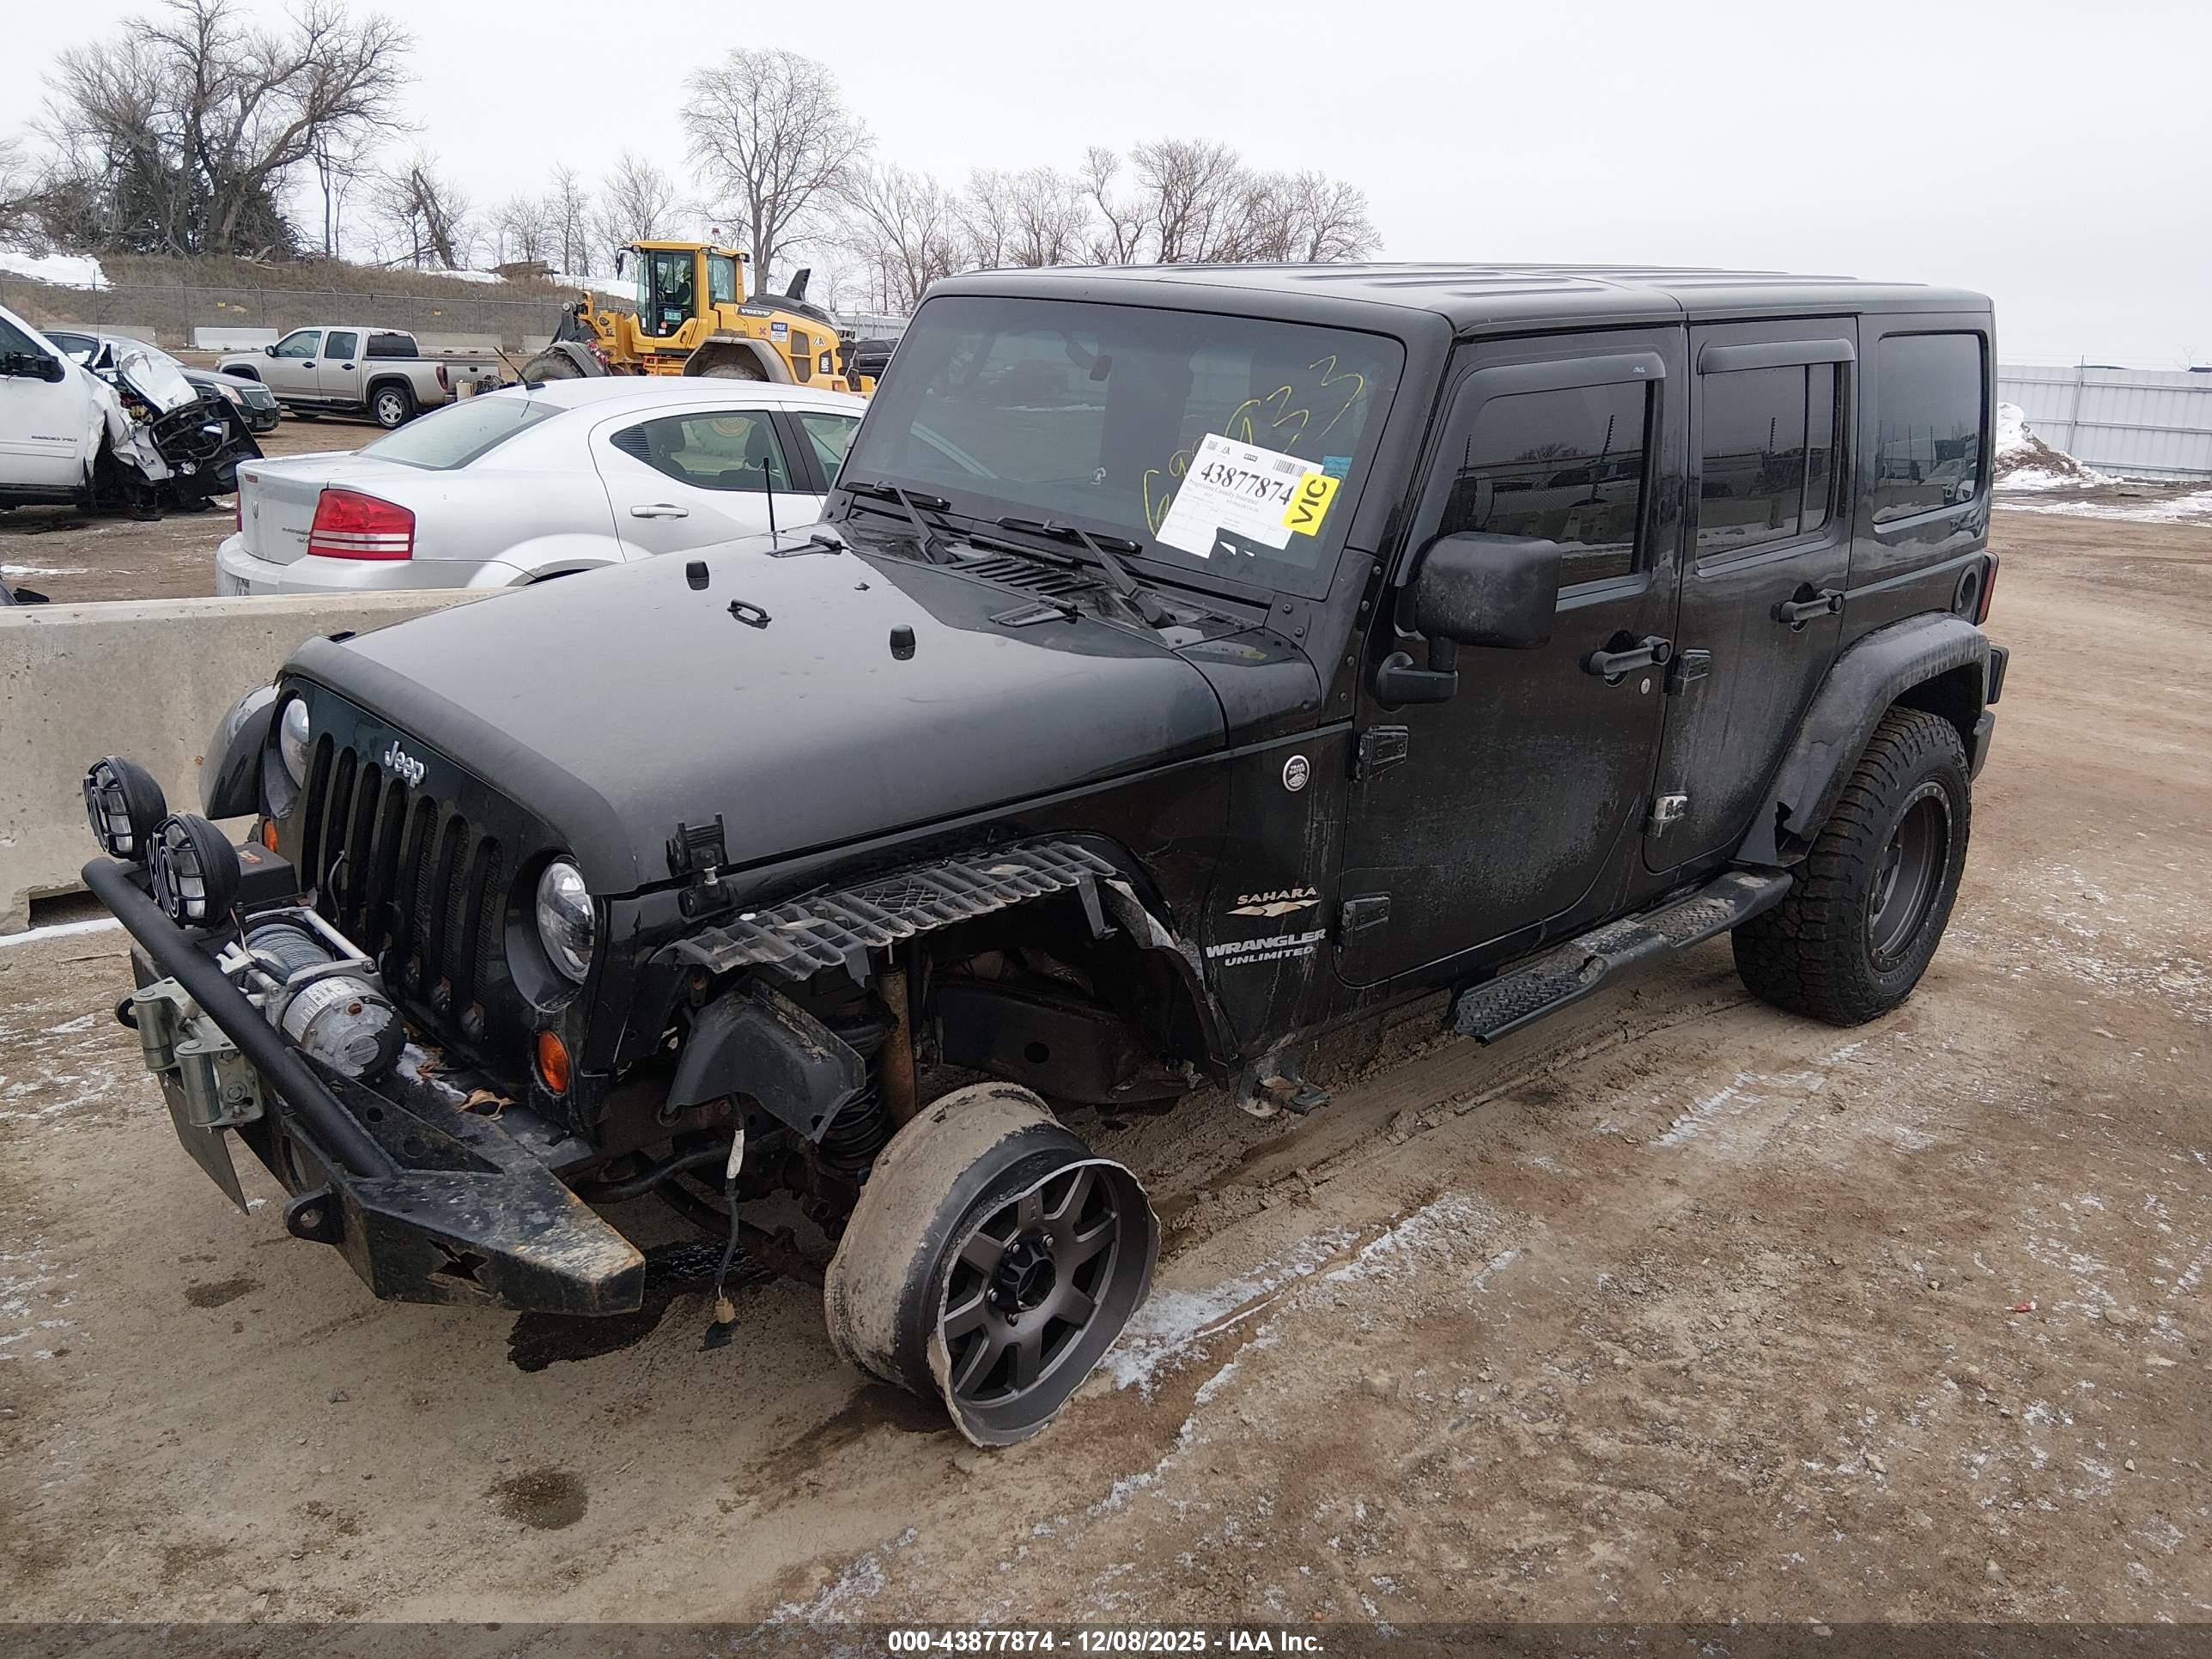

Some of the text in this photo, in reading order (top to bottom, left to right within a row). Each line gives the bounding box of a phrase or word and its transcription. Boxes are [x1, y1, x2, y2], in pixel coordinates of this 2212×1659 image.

[773, 323, 787, 331] WISE
[1200, 461, 1294, 506] 43877874
[1291, 479, 1328, 524] VIC
[385, 740, 424, 788] Jeep
[1237, 886, 1318, 905] SAHARA
[1206, 928, 1327, 958] WRANGLER
[1224, 945, 1315, 967] UNLIMITED
